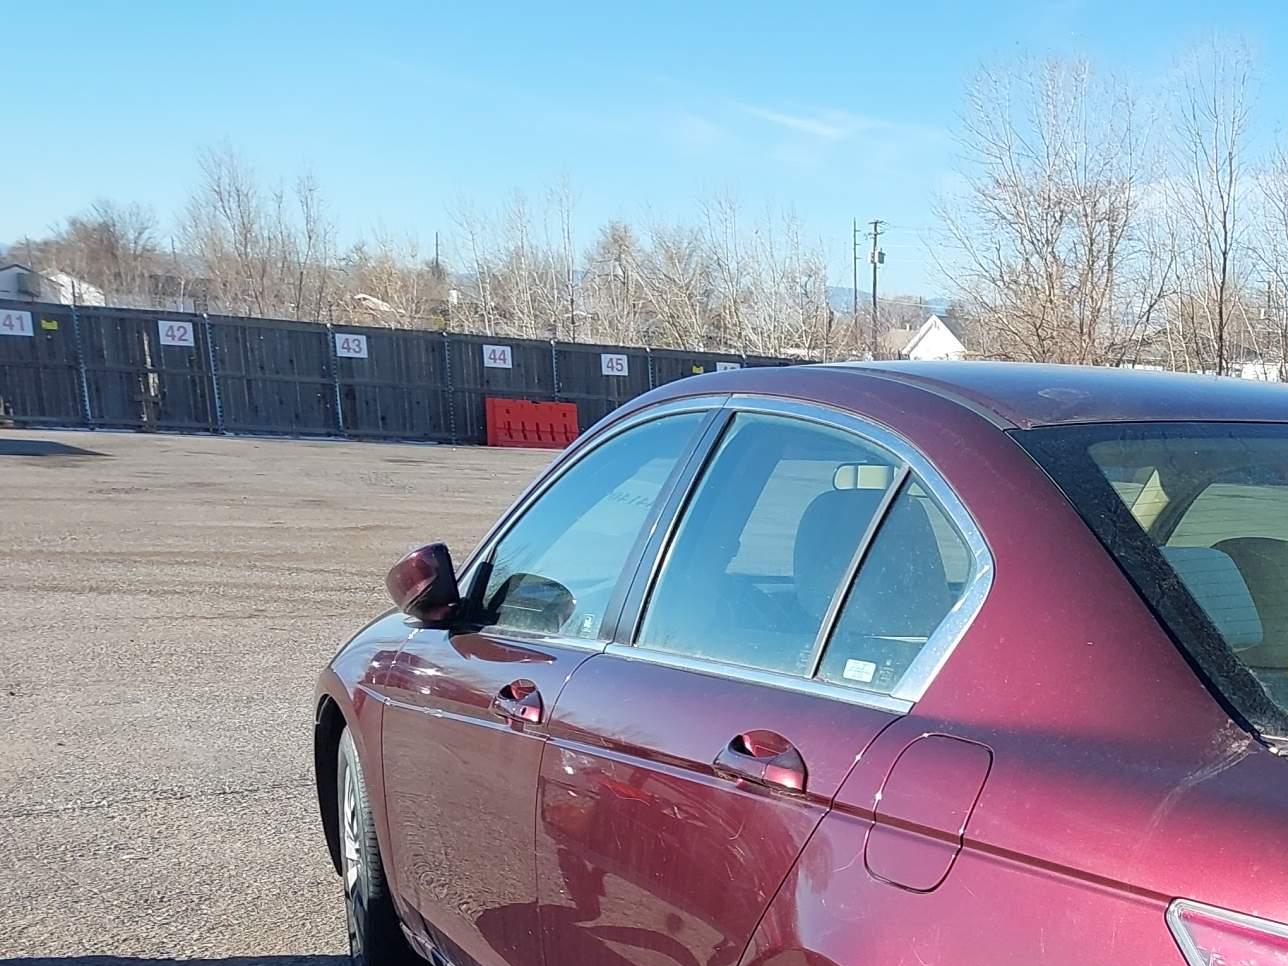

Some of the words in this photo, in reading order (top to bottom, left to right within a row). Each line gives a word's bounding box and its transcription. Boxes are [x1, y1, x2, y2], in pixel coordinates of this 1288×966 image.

[3, 314, 25, 331] 41
[165, 325, 190, 342] 42
[341, 338, 362, 354] 43
[488, 349, 507, 365] 44
[606, 357, 624, 372] 45
